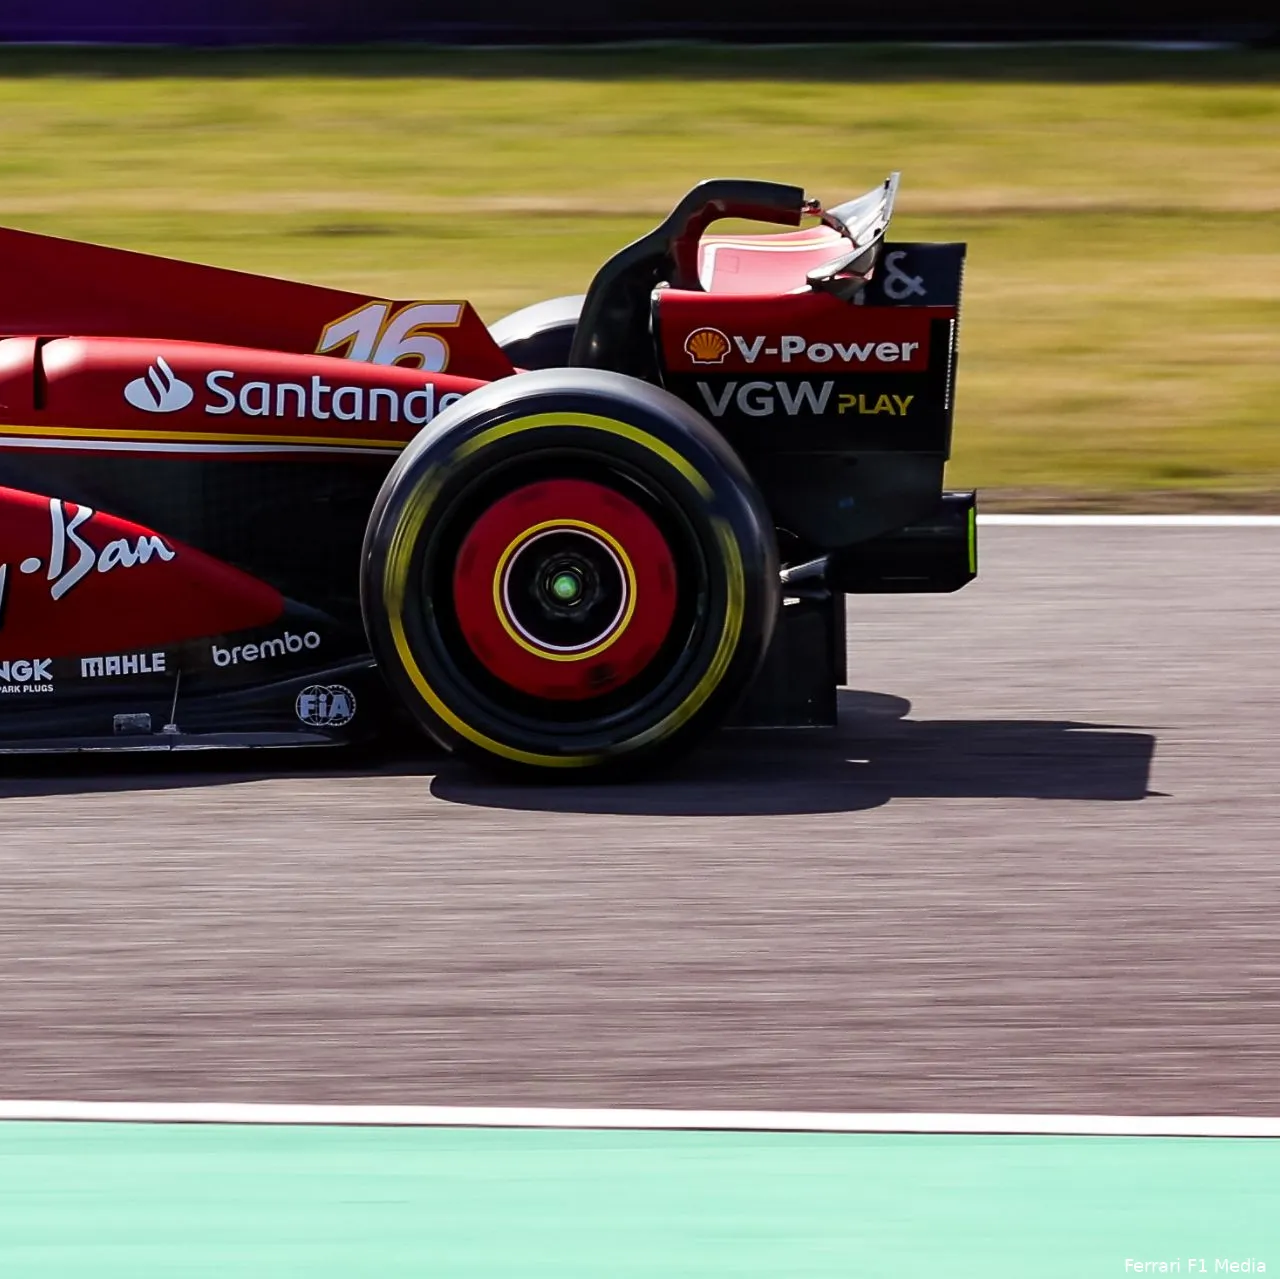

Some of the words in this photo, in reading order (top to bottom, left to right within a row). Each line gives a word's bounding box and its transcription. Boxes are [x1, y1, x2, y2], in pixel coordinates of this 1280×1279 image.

[314, 300, 468, 373] 16
[733, 336, 919, 363] V-Power
[204, 370, 464, 424] Santand
[696, 380, 835, 417] VGW
[838, 394, 915, 416] PLAY
[81, 652, 166, 678] MAHLE
[212, 631, 321, 667] brembo
[23, 683, 54, 693] PLUGS
